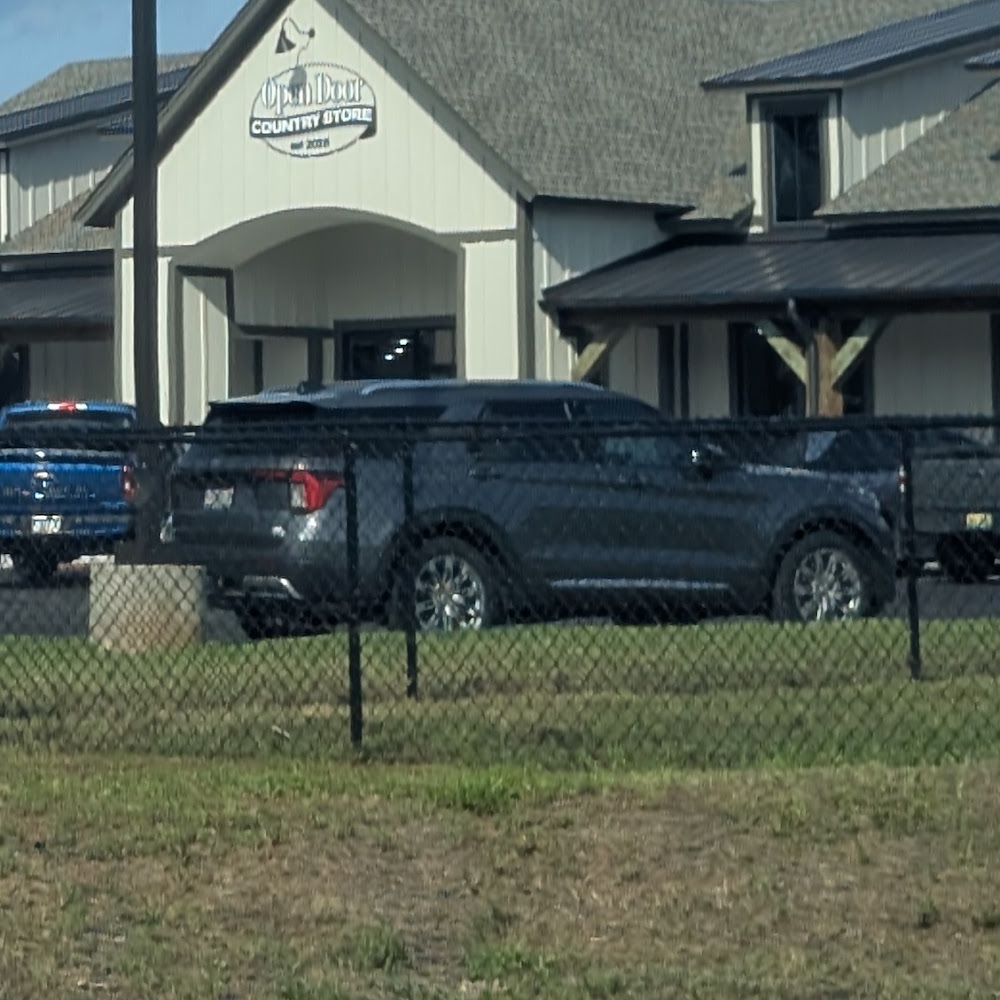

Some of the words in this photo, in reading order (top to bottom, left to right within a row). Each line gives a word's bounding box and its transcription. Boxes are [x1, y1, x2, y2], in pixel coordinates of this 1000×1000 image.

[315, 73, 365, 104] Door
[252, 112, 320, 134] COUNTRY
[322, 107, 372, 125] STORE
